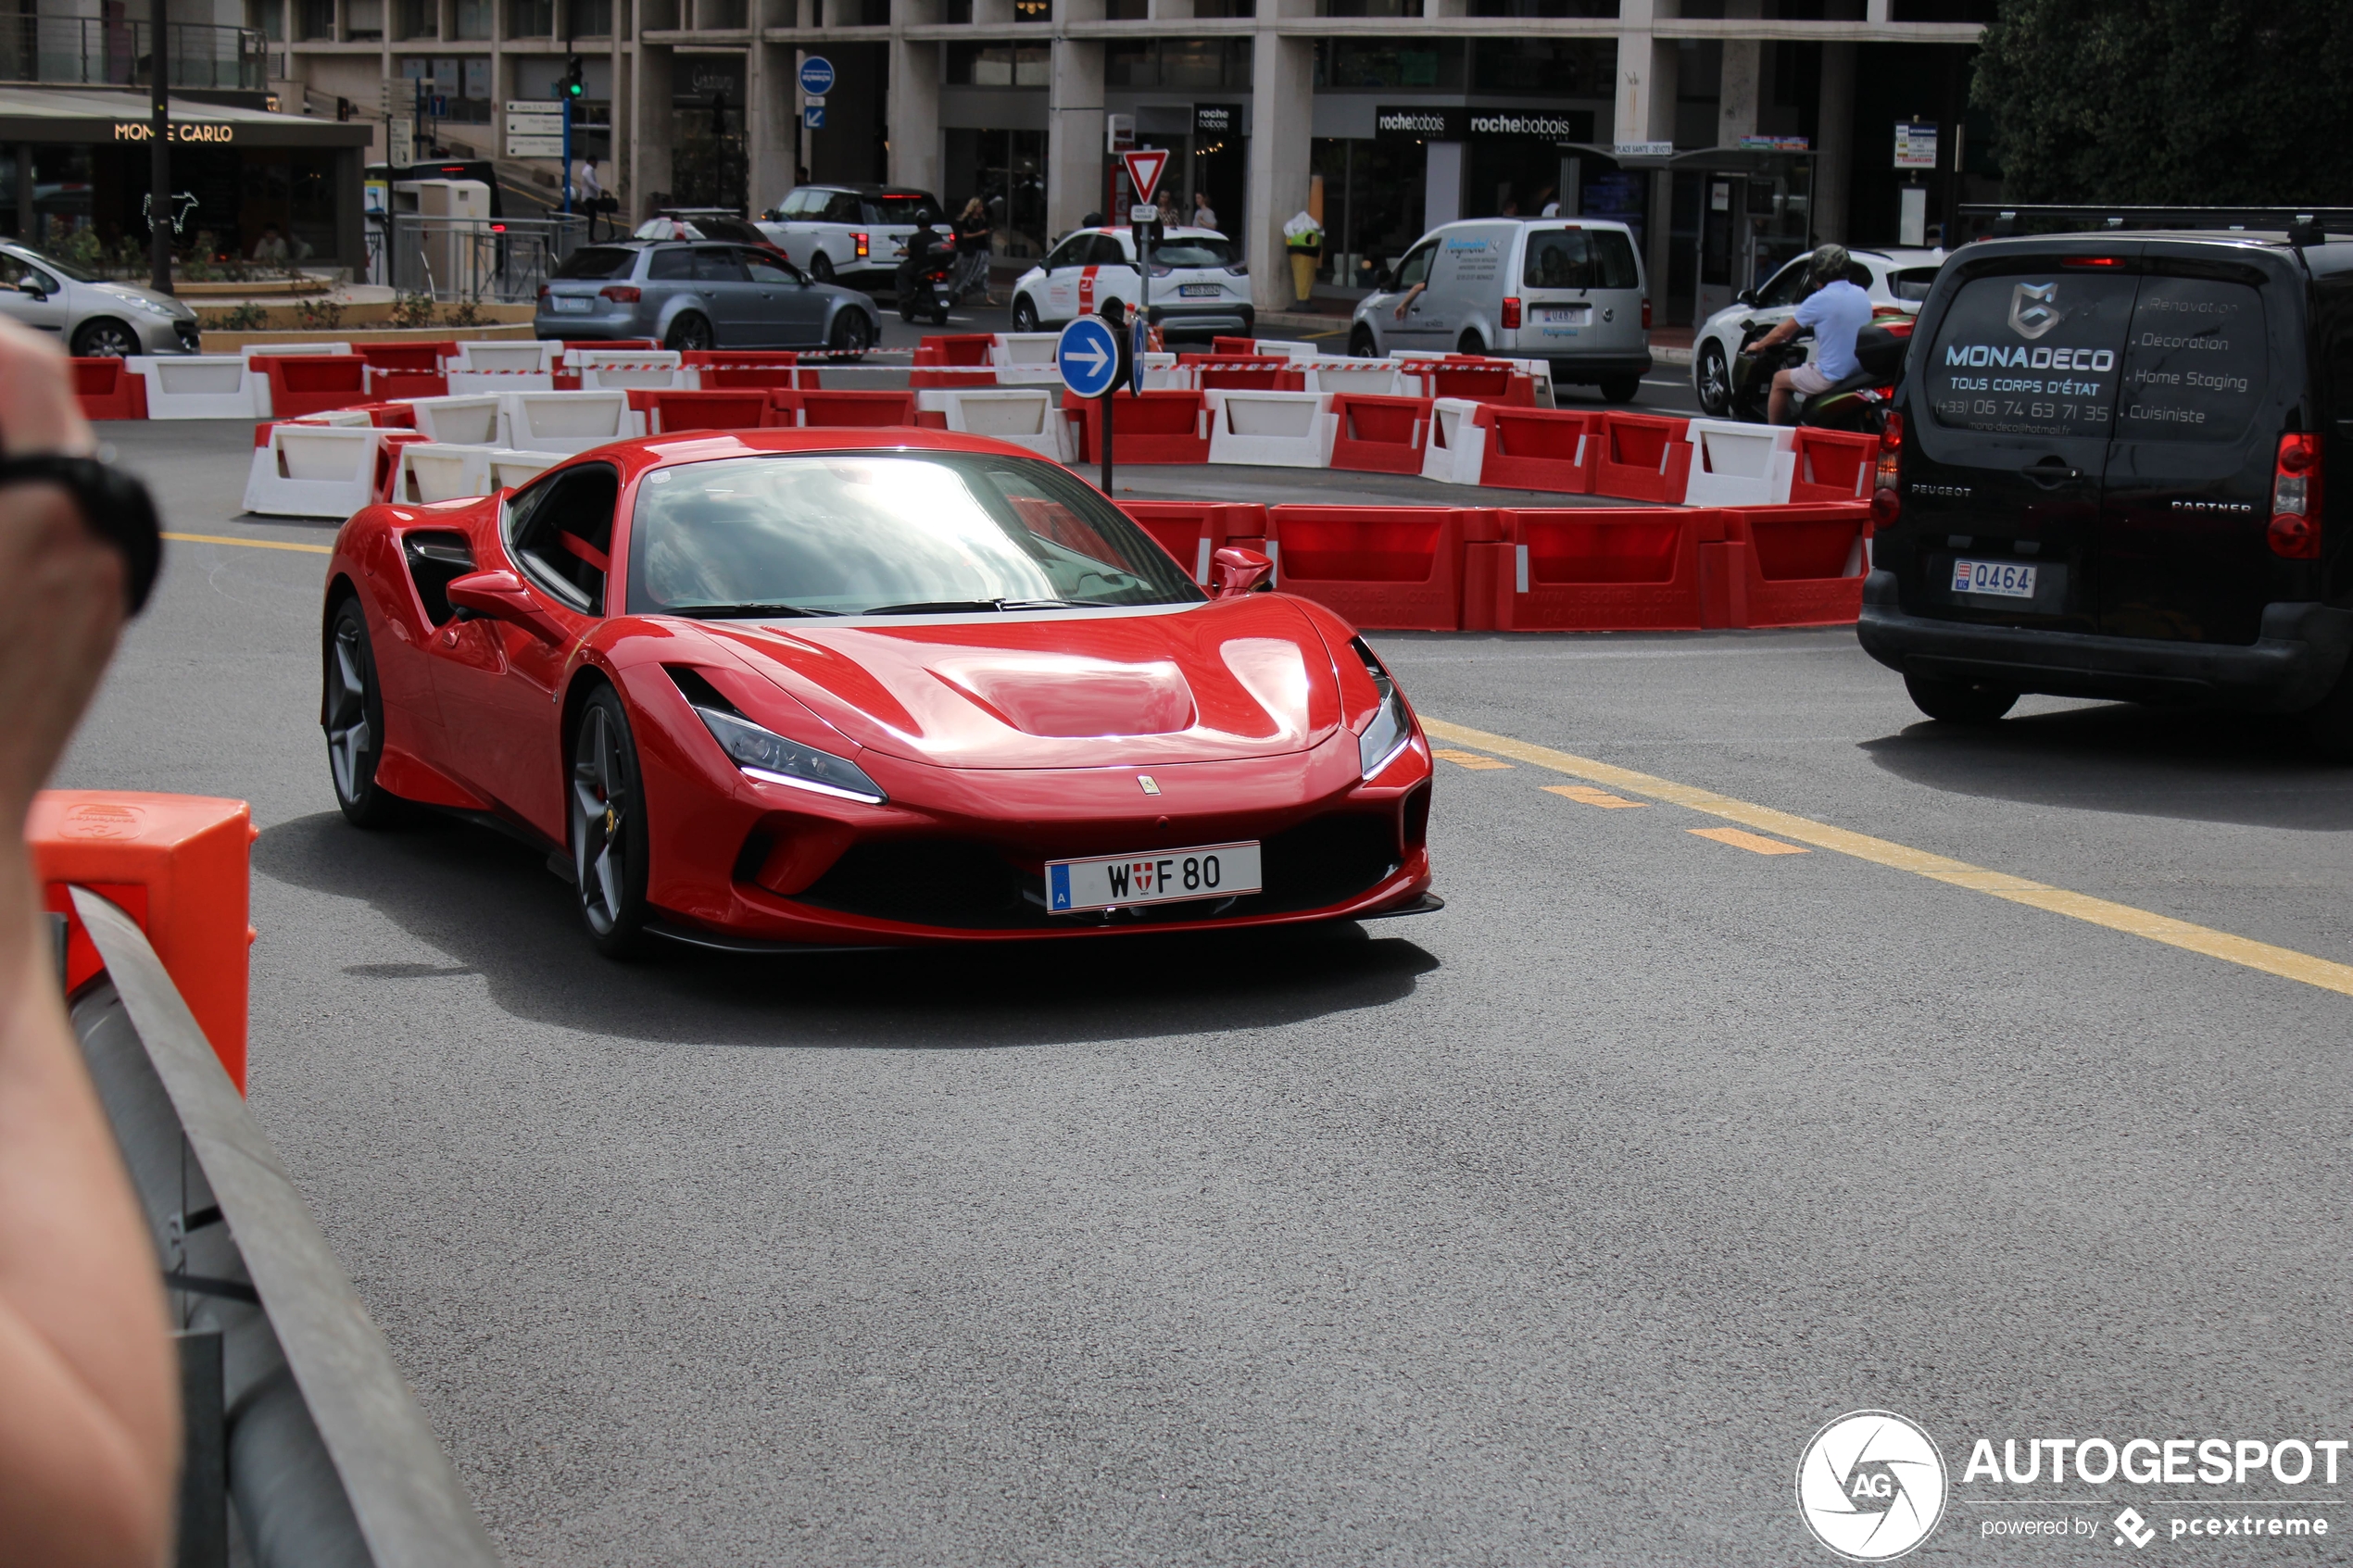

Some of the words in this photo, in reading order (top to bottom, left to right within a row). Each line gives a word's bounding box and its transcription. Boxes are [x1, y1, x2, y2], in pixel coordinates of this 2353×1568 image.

[1199, 108, 1229, 119] roche
[1379, 113, 1445, 131] rochebobois
[115, 123, 175, 141] MONE
[180, 124, 233, 143] CARLO
[1199, 119, 1228, 129] bobois
[1471, 115, 1570, 134] rochebobois
[1616, 145, 1630, 154] PLACE
[2148, 297, 2239, 314] Rénovation
[2141, 332, 2229, 350] Décoration
[1945, 345, 2115, 372] MONADECO
[1950, 377, 1989, 391] TOUS
[1993, 378, 2043, 393] CORPS
[2046, 378, 2101, 396] D'ÉTAT
[2134, 369, 2181, 384] Home
[2186, 371, 2248, 393] Staging
[1935, 398, 1969, 416] (+33)
[1973, 399, 1996, 415] 06
[2004, 400, 2024, 417] 74
[2031, 402, 2055, 419] 63
[2062, 404, 2078, 420] 71
[2083, 406, 2109, 422] 35
[2129, 405, 2205, 423] Cuisiniste
[1911, 483, 1971, 497] PEUGEOT
[2171, 501, 2252, 514] PARTNER
[1957, 581, 1969, 589] MC
[1975, 564, 2029, 591] Q464
[1057, 892, 1066, 904] A
[1108, 863, 1130, 898] W
[1156, 859, 1174, 894] F
[1182, 854, 1220, 891] 80
